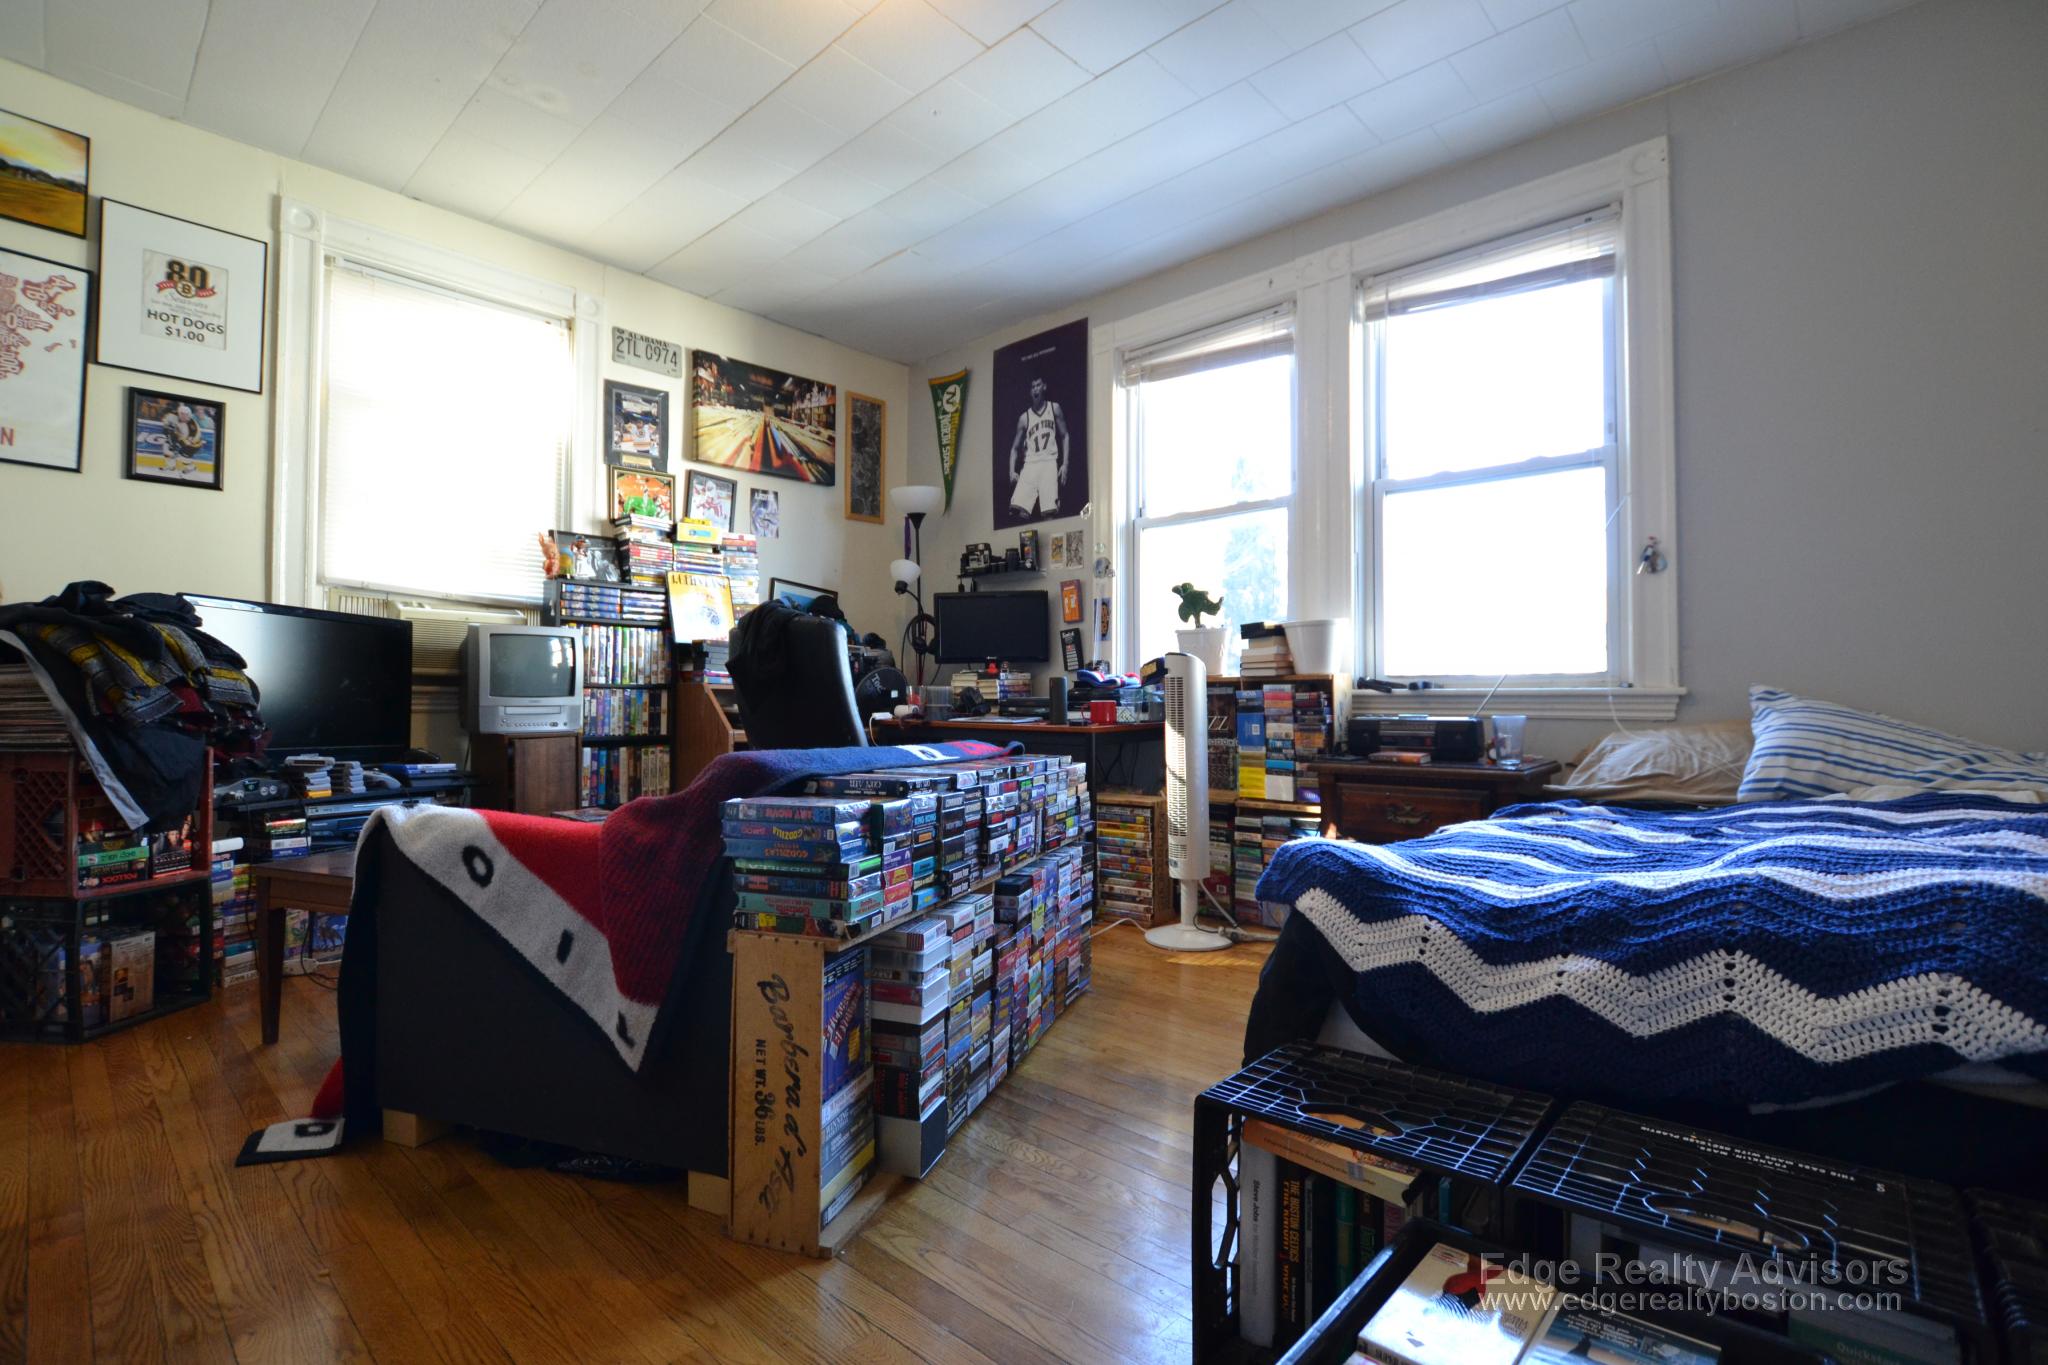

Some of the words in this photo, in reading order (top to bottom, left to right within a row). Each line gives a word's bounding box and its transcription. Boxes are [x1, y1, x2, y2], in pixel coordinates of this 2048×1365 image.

[147, 309, 180, 324] HOT
[183, 317, 224, 334] DOGS
[165, 326, 205, 342] $1.00
[628, 331, 668, 347] ALABAMA
[616, 335, 641, 358] 2TL
[645, 343, 678, 367] 0974
[1028, 423, 1040, 438] NEW
[1041, 419, 1055, 430] YORK
[1033, 432, 1051, 453] 17
[772, 826, 803, 840] GODZILLA
[755, 1038, 766, 1065] NET
[755, 1121, 766, 1147] LBS.
[1252, 1180, 1260, 1202] Steve
[1290, 1180, 1300, 1196] THE
[1252, 1203, 1260, 1222] Jobs
[1290, 1197, 1300, 1229] BOSTON
[1290, 1230, 1300, 1263] CELTICS
